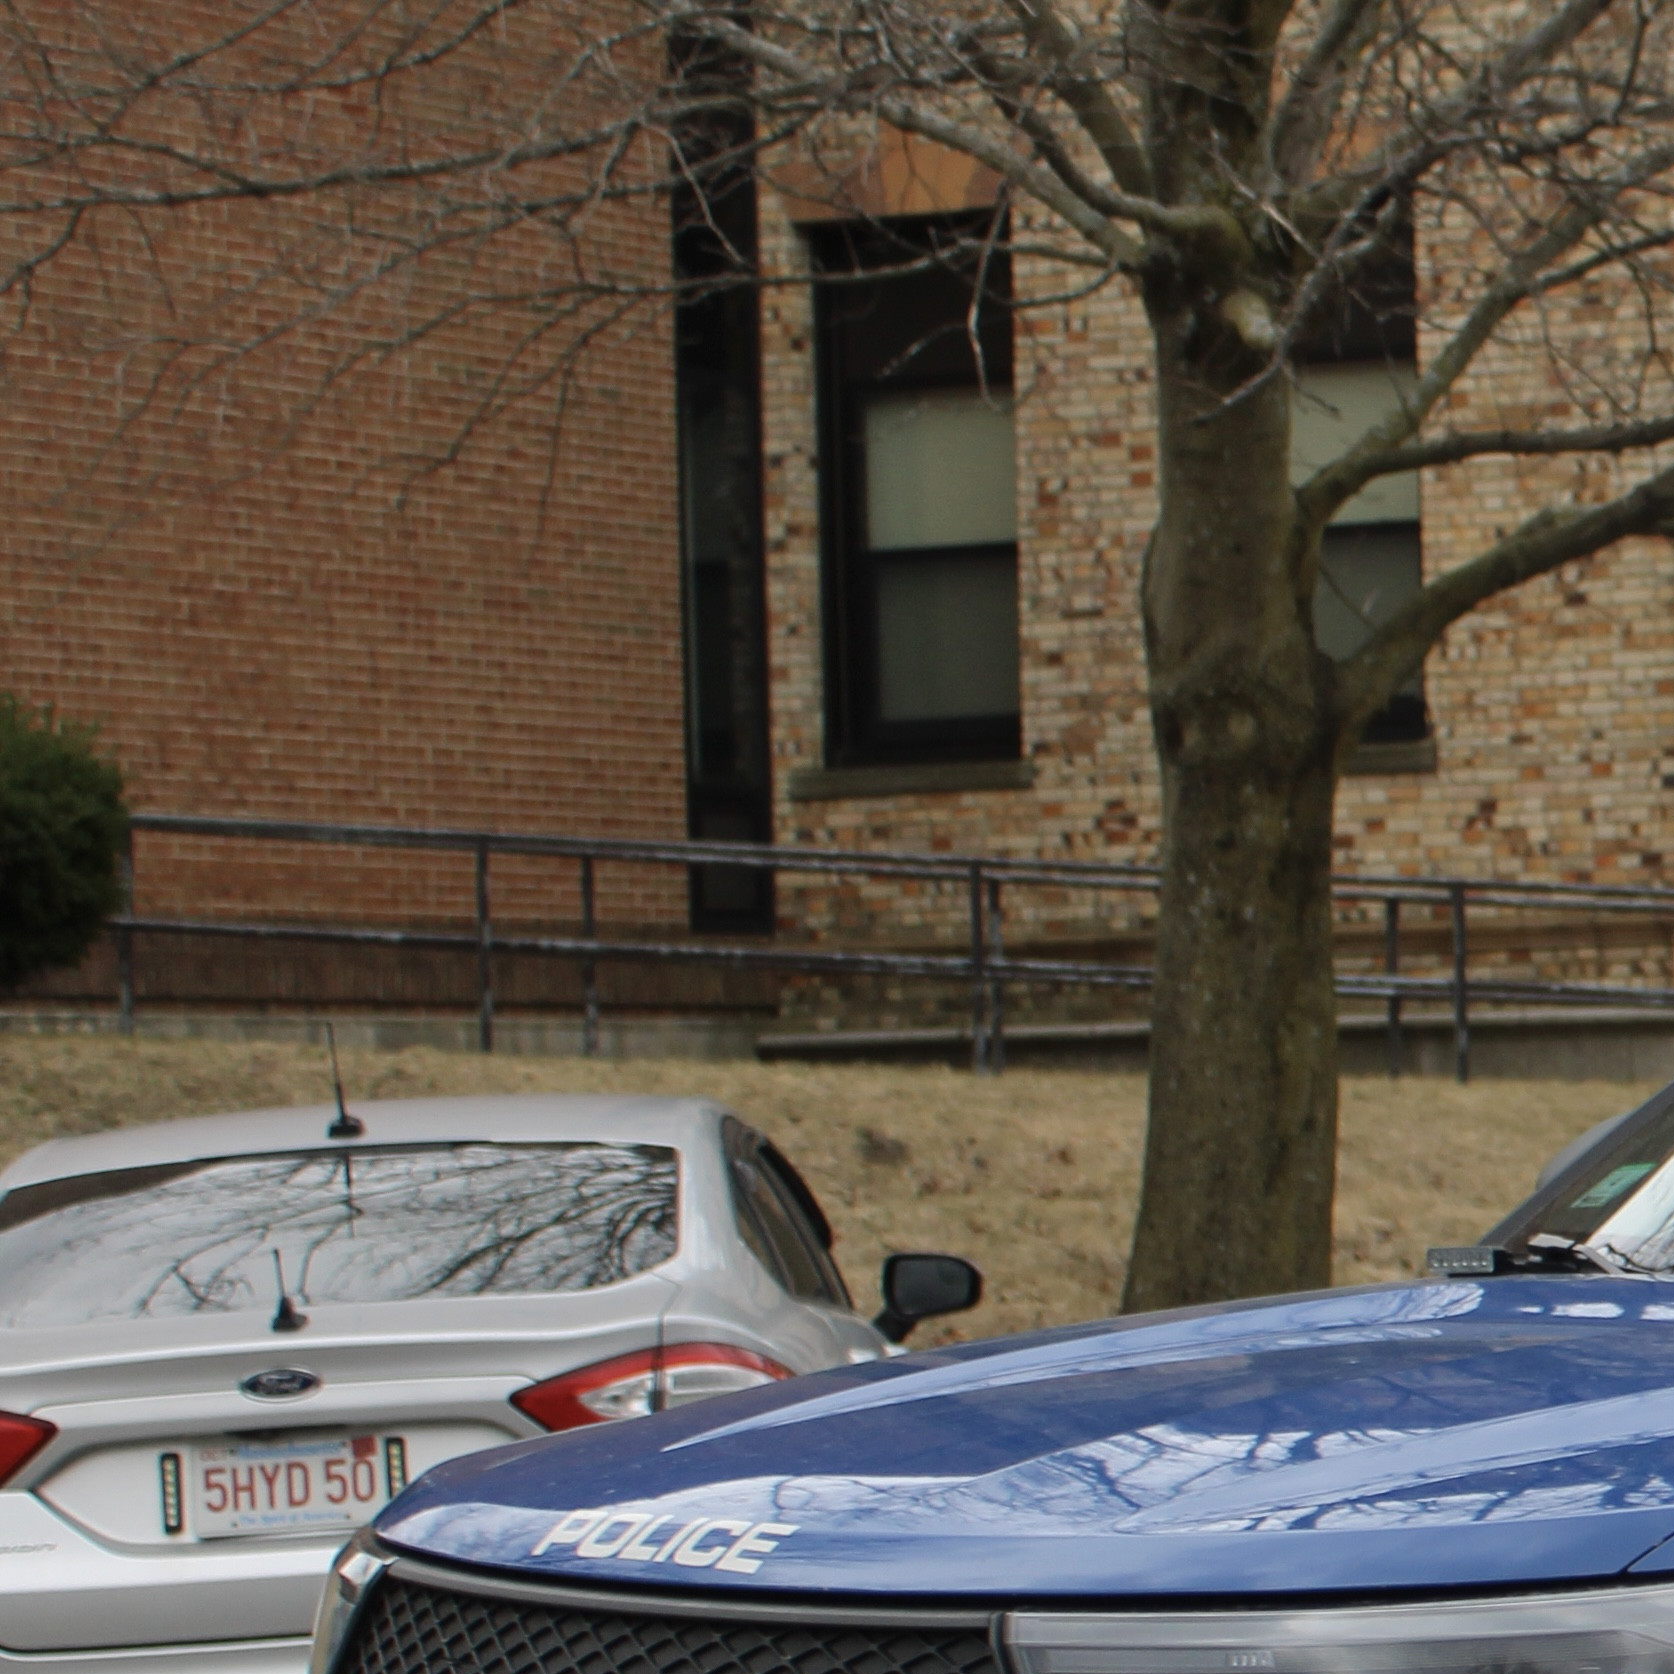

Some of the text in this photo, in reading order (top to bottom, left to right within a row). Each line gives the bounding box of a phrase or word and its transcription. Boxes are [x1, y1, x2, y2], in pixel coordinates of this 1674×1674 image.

[204, 1458, 376, 1512] 5HYD 50
[530, 1509, 802, 1575] POLICE
